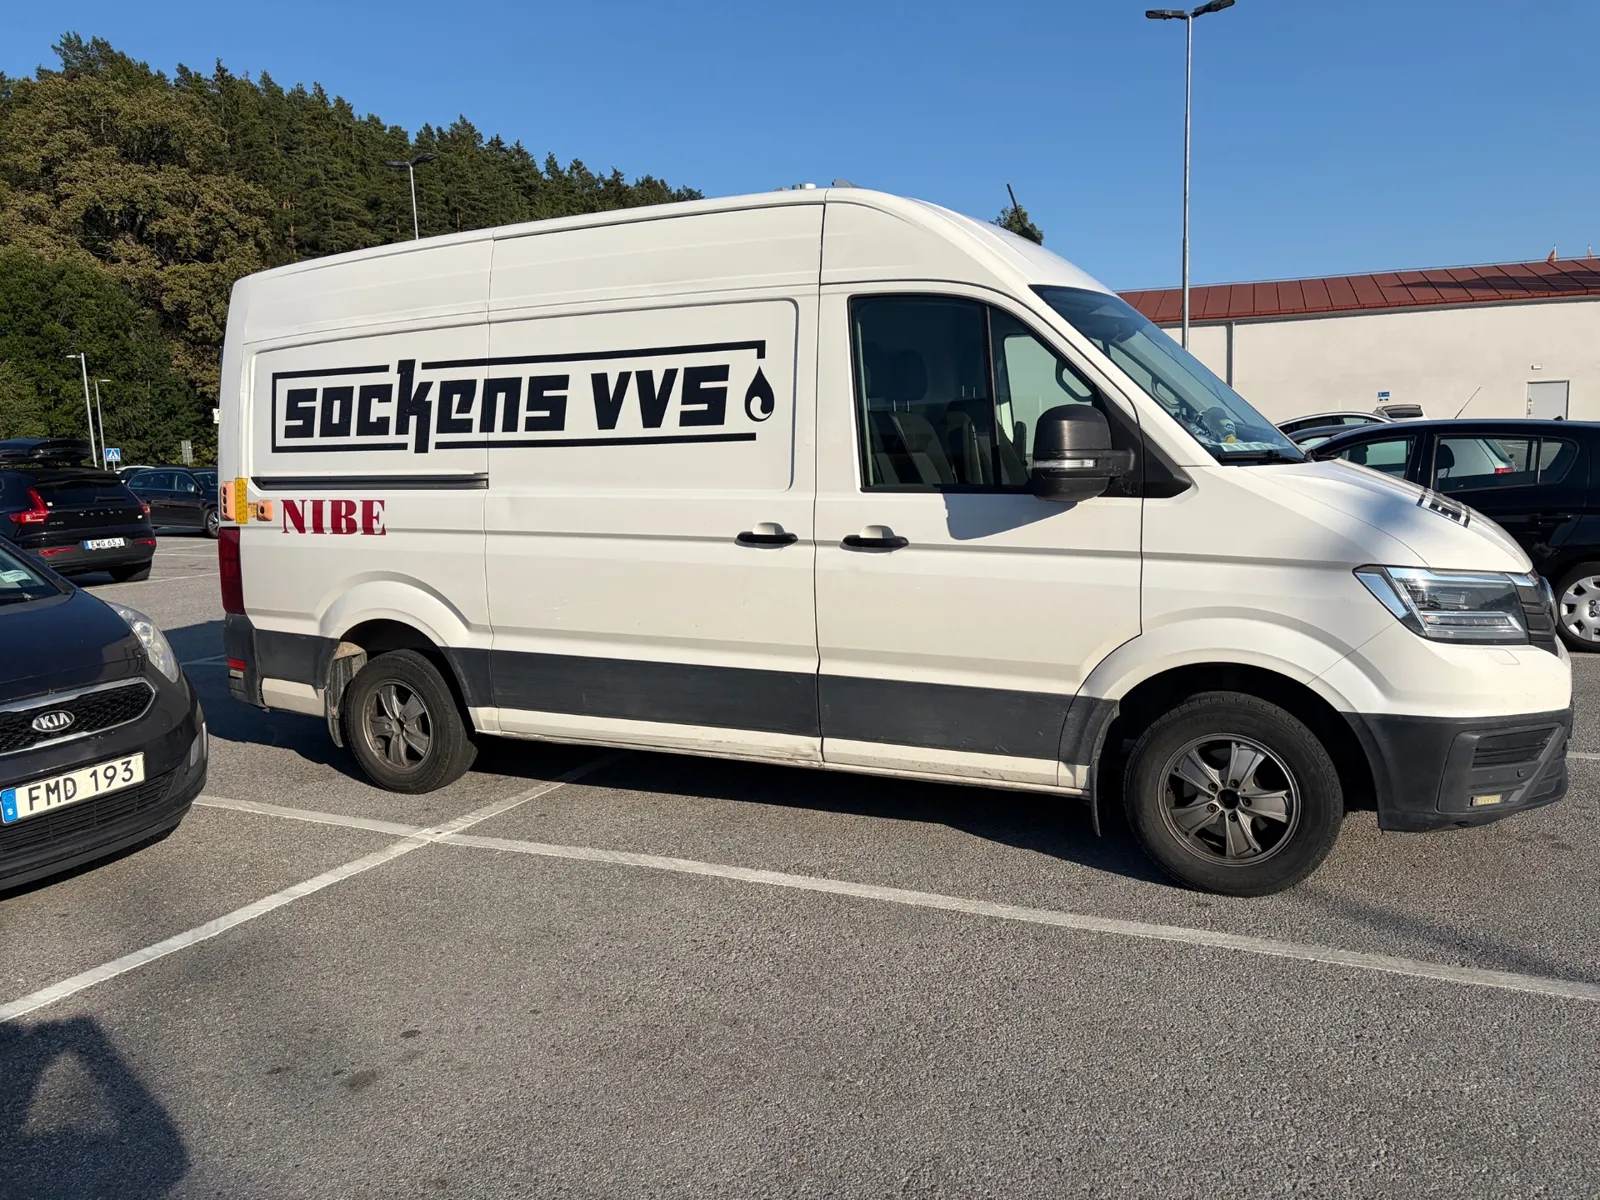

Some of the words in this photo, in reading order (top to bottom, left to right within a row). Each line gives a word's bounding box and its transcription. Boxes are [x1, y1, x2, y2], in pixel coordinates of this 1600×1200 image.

[281, 499, 386, 536] NIBE
[90, 540, 106, 548] EWG
[39, 712, 71, 729] KIA
[27, 777, 77, 811] FMD
[89, 760, 134, 792] 193
[7, 808, 14, 816] S
